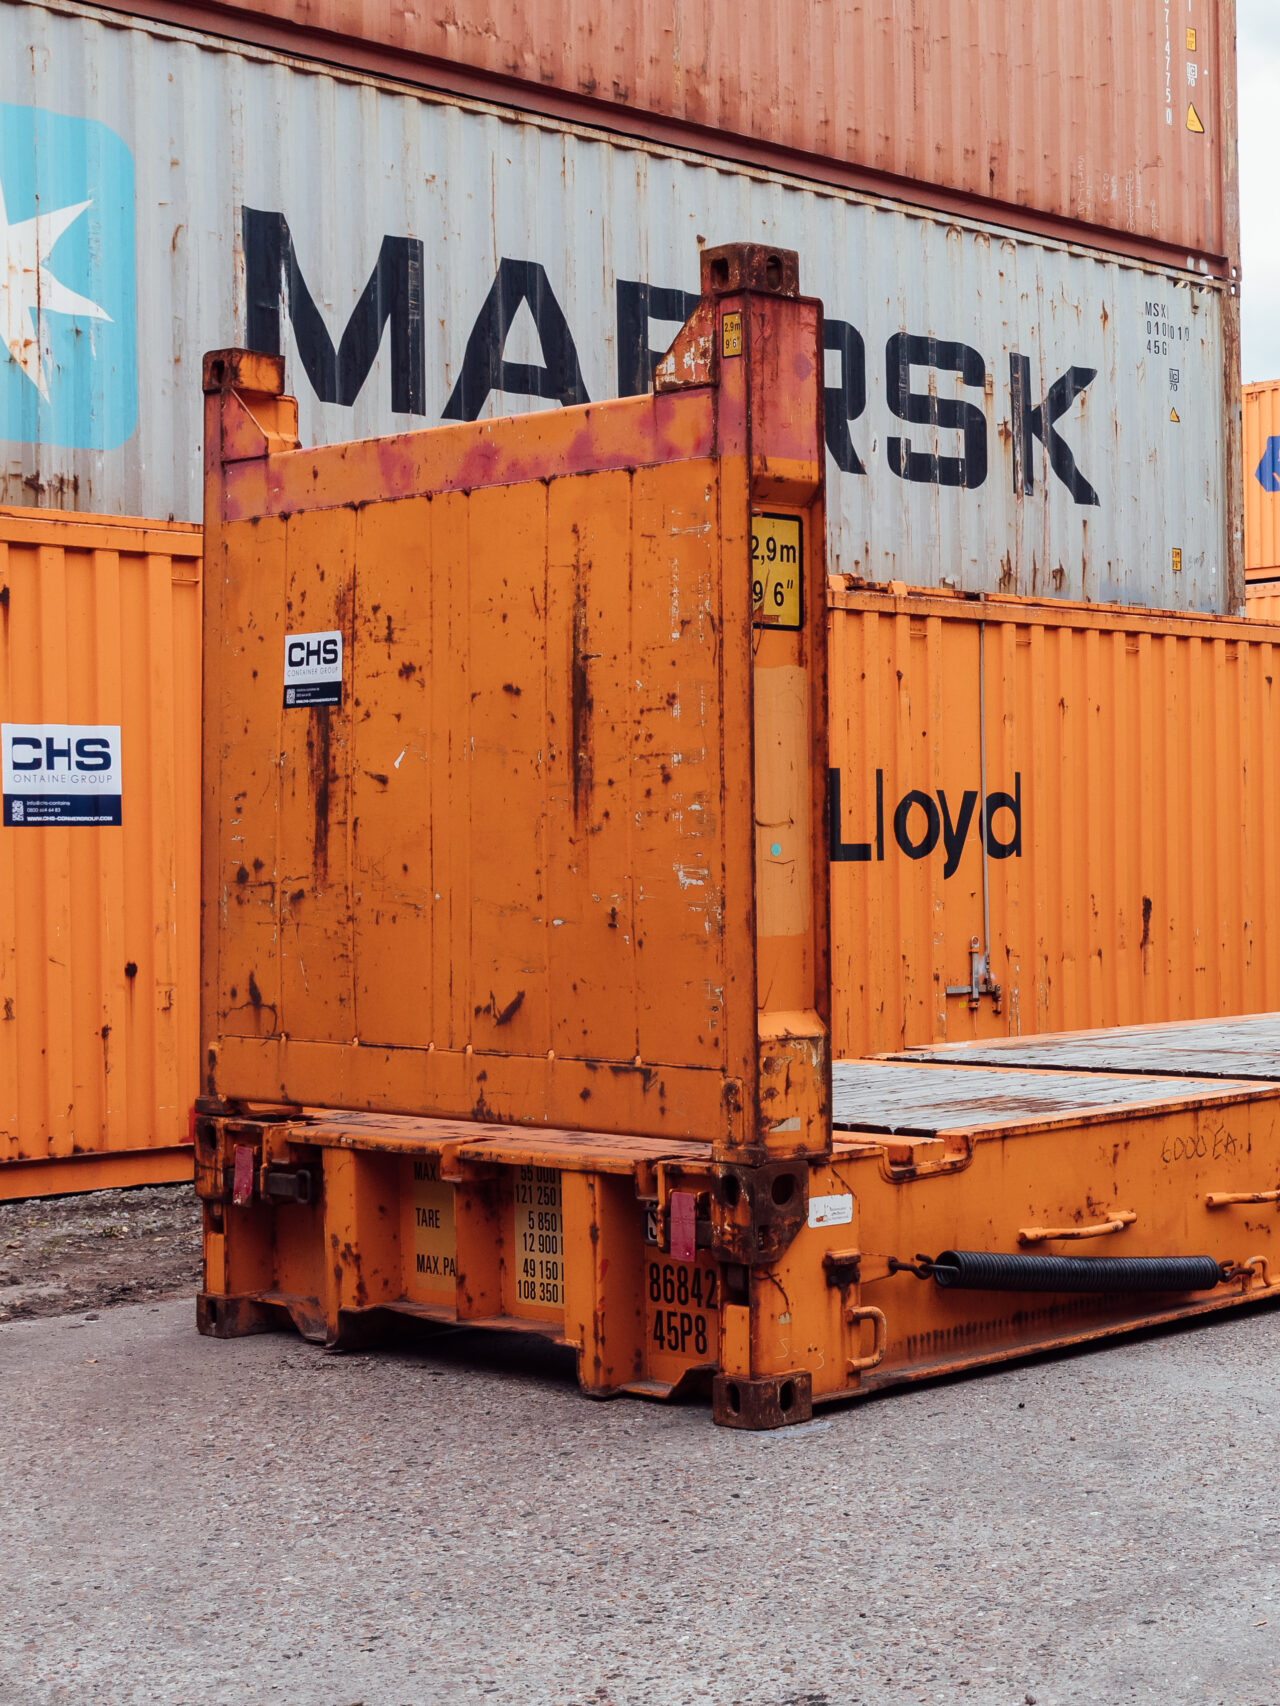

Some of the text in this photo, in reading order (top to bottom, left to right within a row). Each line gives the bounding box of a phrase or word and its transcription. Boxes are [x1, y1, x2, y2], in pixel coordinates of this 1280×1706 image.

[288, 639, 338, 668] CHS
[12, 736, 112, 771] CHS
[71, 774, 113, 784] GROUP
[829, 768, 1022, 880] Lloyd
[515, 1184, 557, 1207] 121 250
[415, 1207, 441, 1229] TARE
[537, 1212, 557, 1233] 850
[522, 1232, 558, 1255] 12 900
[523, 1258, 558, 1281] 49 150
[517, 1280, 559, 1303] 108 350
[653, 1309, 708, 1355] 45P8
